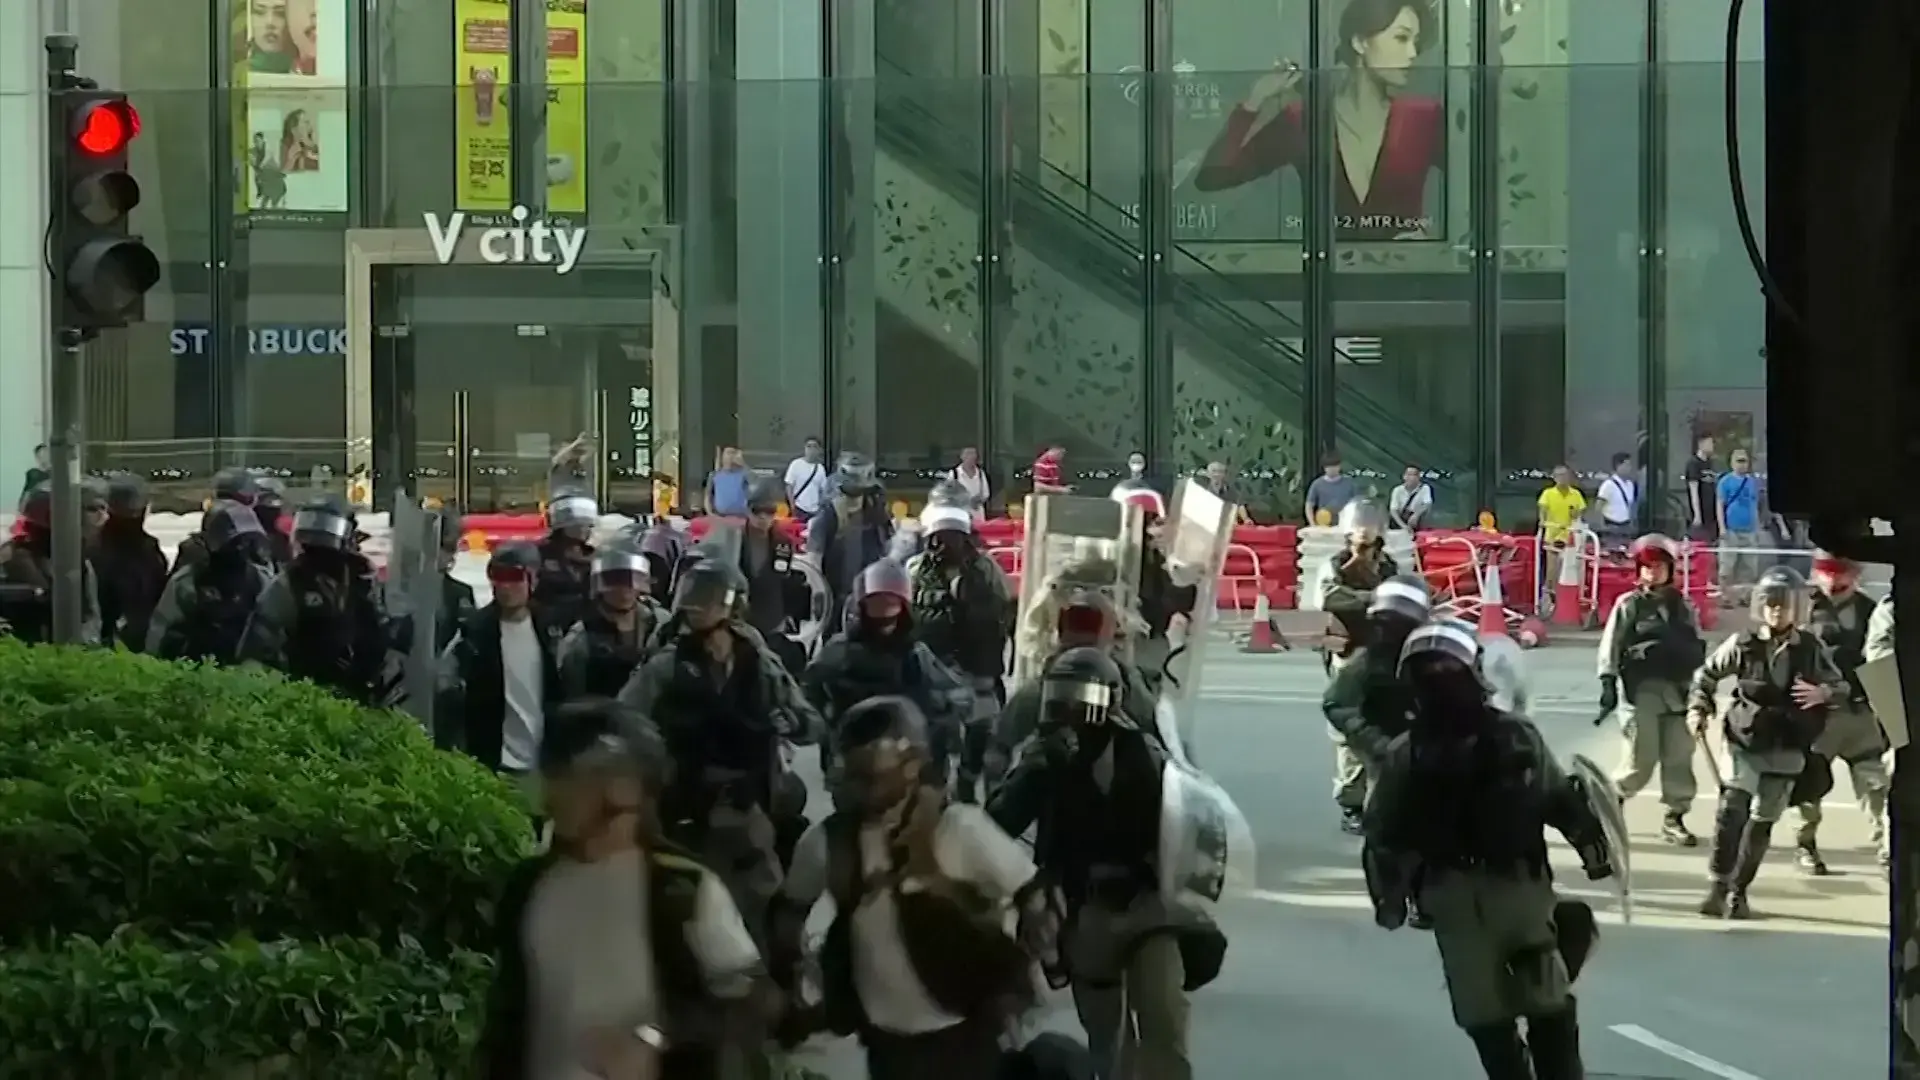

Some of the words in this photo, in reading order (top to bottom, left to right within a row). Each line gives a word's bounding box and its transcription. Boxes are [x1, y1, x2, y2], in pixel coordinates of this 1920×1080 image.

[423, 211, 465, 264] V
[479, 205, 587, 275] city
[1359, 215, 1392, 228] MTR
